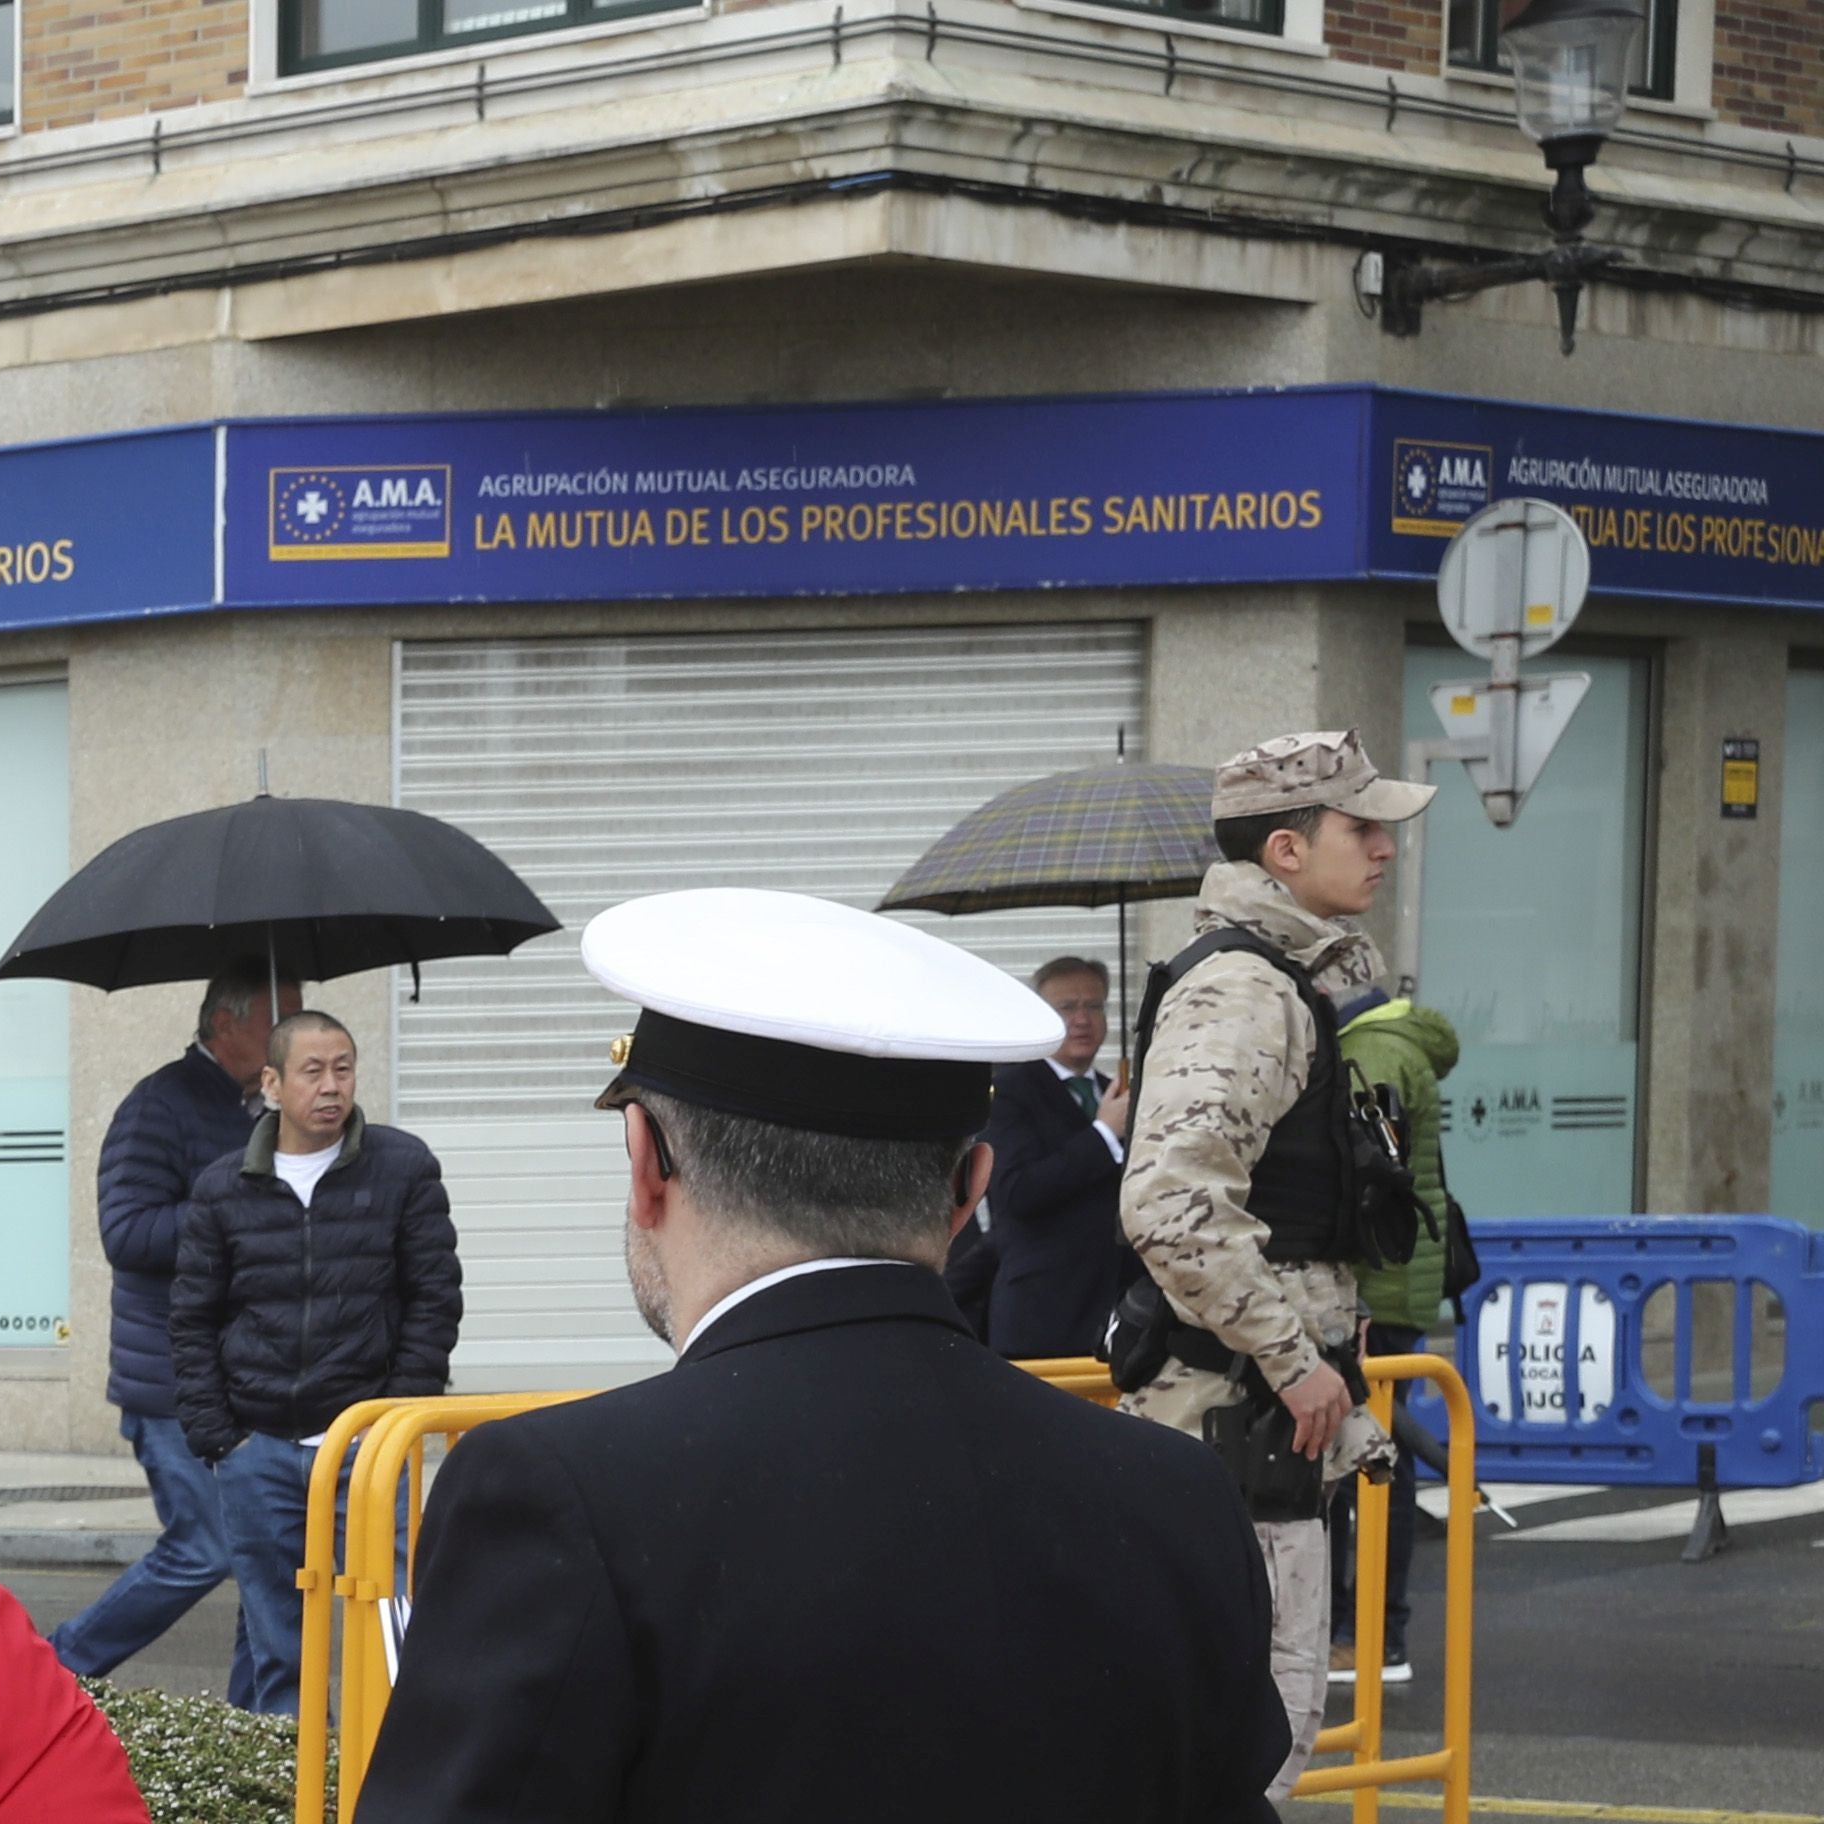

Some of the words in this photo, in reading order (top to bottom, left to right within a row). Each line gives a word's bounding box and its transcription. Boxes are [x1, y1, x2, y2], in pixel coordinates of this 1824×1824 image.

[352, 478, 442, 507] A.M.A.
[478, 467, 629, 498] AGRUPACIÓN
[635, 470, 732, 494] MUTUAL
[737, 464, 917, 491] ASEGURADORA
[1508, 456, 1601, 491] AGRUPACIÓN
[1603, 464, 1663, 496] MUTUAL
[1664, 470, 1769, 505] ASEGURADORA
[474, 512, 516, 551] LA
[525, 509, 654, 549] MUTUA
[665, 507, 711, 546] DE
[722, 505, 790, 545] LOS
[801, 497, 1092, 542] PROFESIONALES
[1102, 490, 1322, 534] SANITARIOS
[1623, 508, 1651, 549] DE
[1657, 512, 1696, 554] LOS
[1496, 1343, 1596, 1362] POLICA
[1521, 1368, 1562, 1381] LOCA
